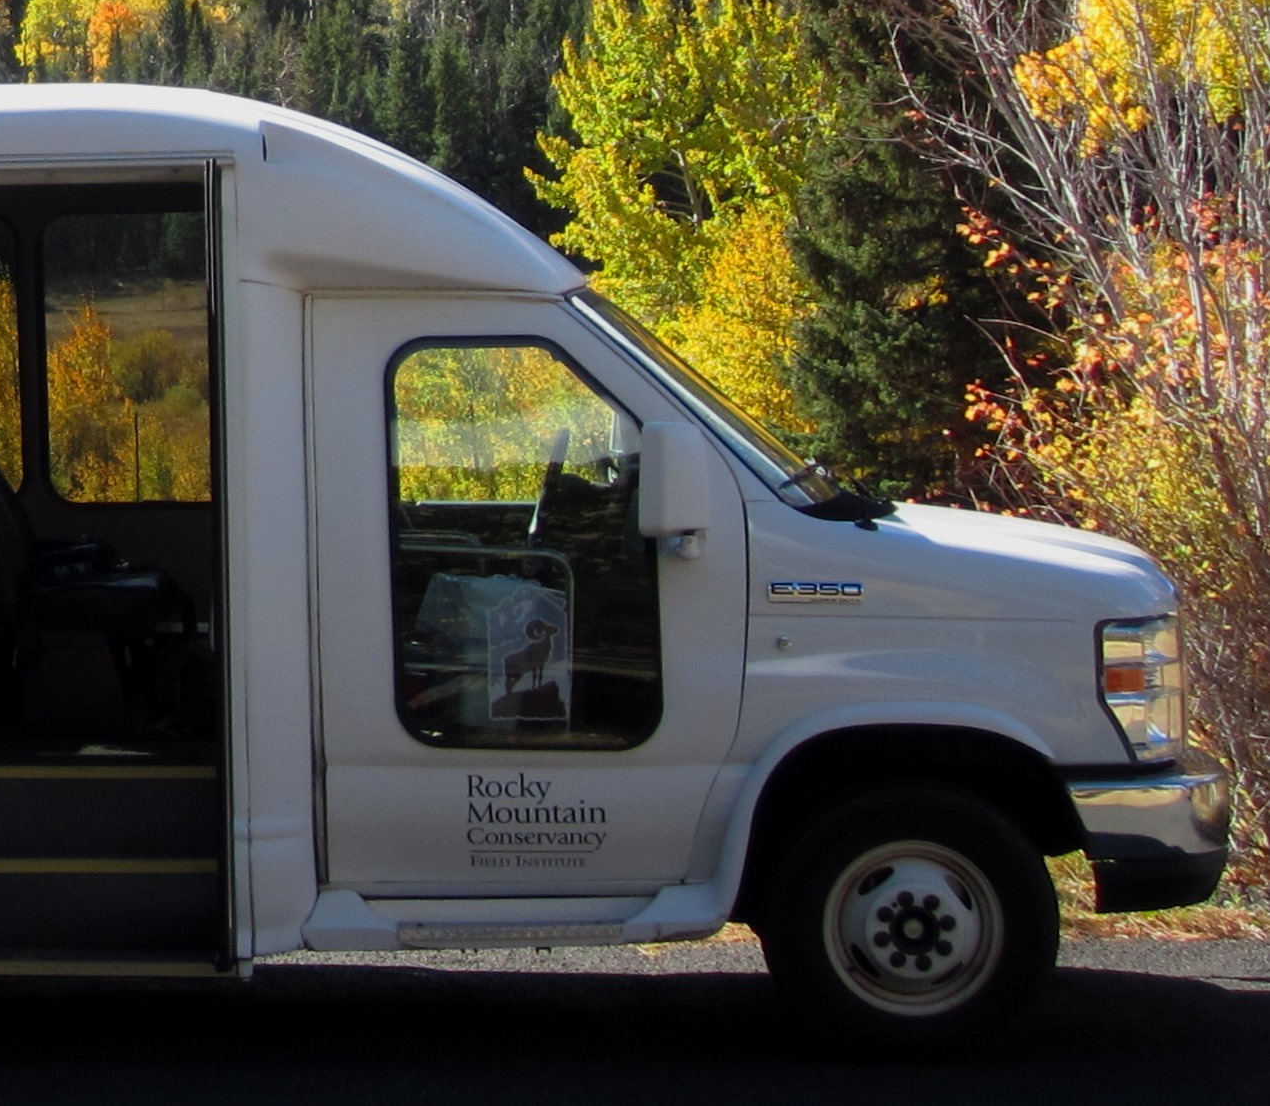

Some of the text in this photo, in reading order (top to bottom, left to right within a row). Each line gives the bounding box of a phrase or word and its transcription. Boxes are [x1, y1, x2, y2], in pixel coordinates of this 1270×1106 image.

[466, 772, 552, 805] Rocky
[467, 800, 607, 824] Mountain
[466, 827, 607, 850] Conservancy
[470, 855, 586, 868] FIELD INSTITUTE
